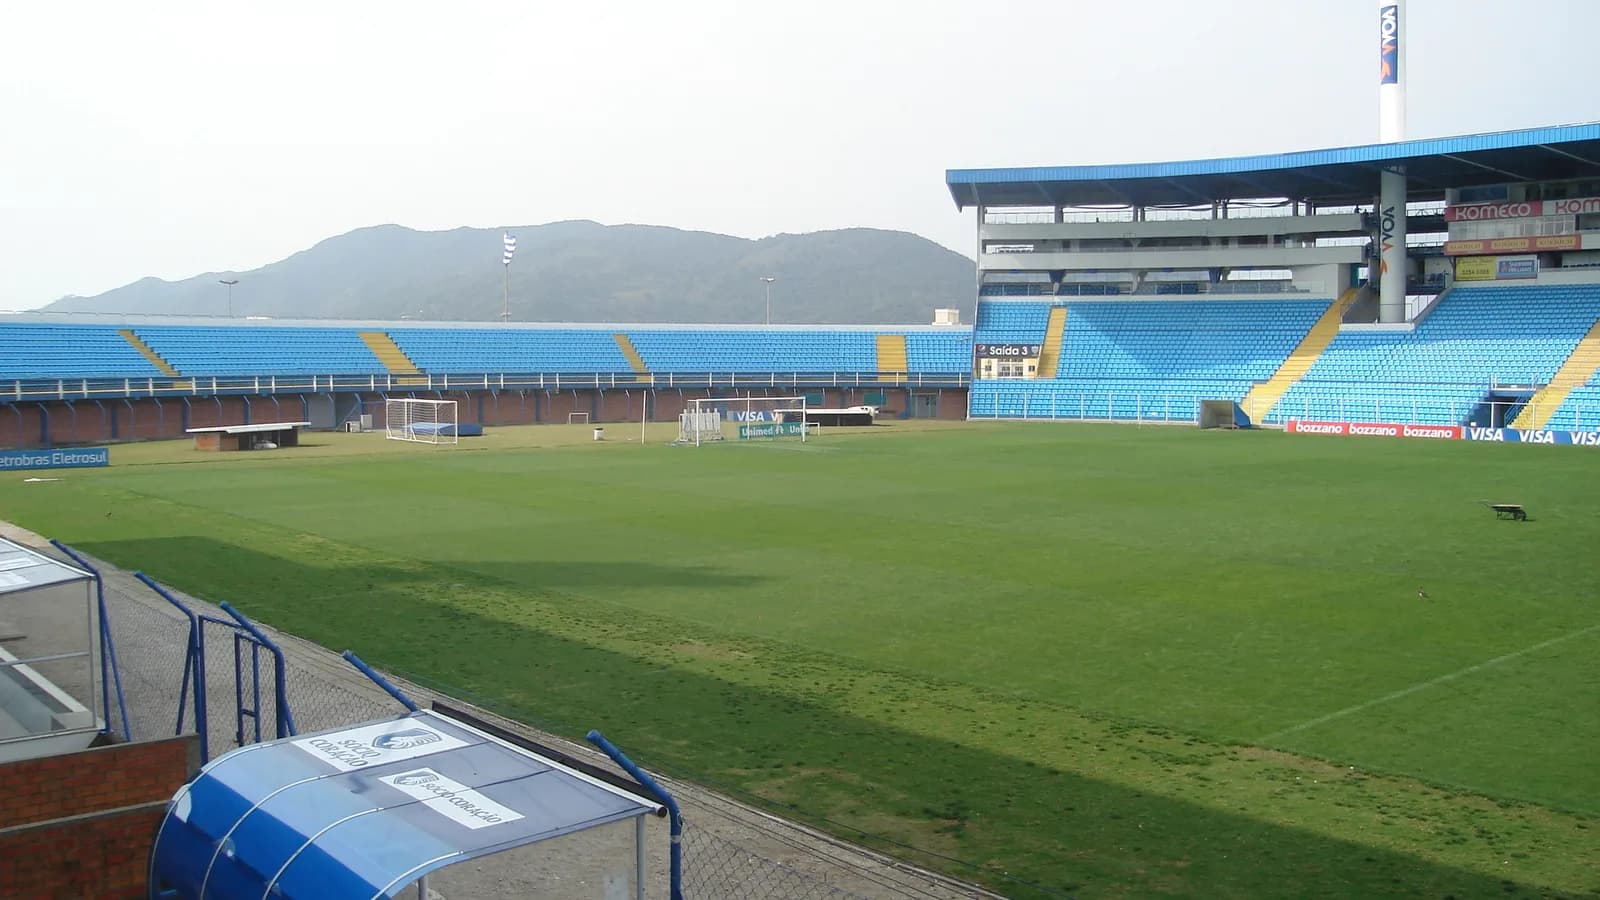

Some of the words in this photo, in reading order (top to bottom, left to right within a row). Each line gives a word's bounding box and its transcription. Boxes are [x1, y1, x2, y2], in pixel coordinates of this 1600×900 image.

[1455, 203, 1531, 220] KOMECO
[990, 345, 1019, 355] Saída
[1021, 346, 1028, 355] 3
[742, 426, 773, 437] Unimed
[1296, 423, 1343, 434] bozzano
[1349, 423, 1397, 436] bozzano
[1403, 425, 1452, 438] bozzano
[1470, 428, 1504, 441] VISA
[1519, 430, 1554, 444] VISA
[52, 451, 106, 465] Eletrosul
